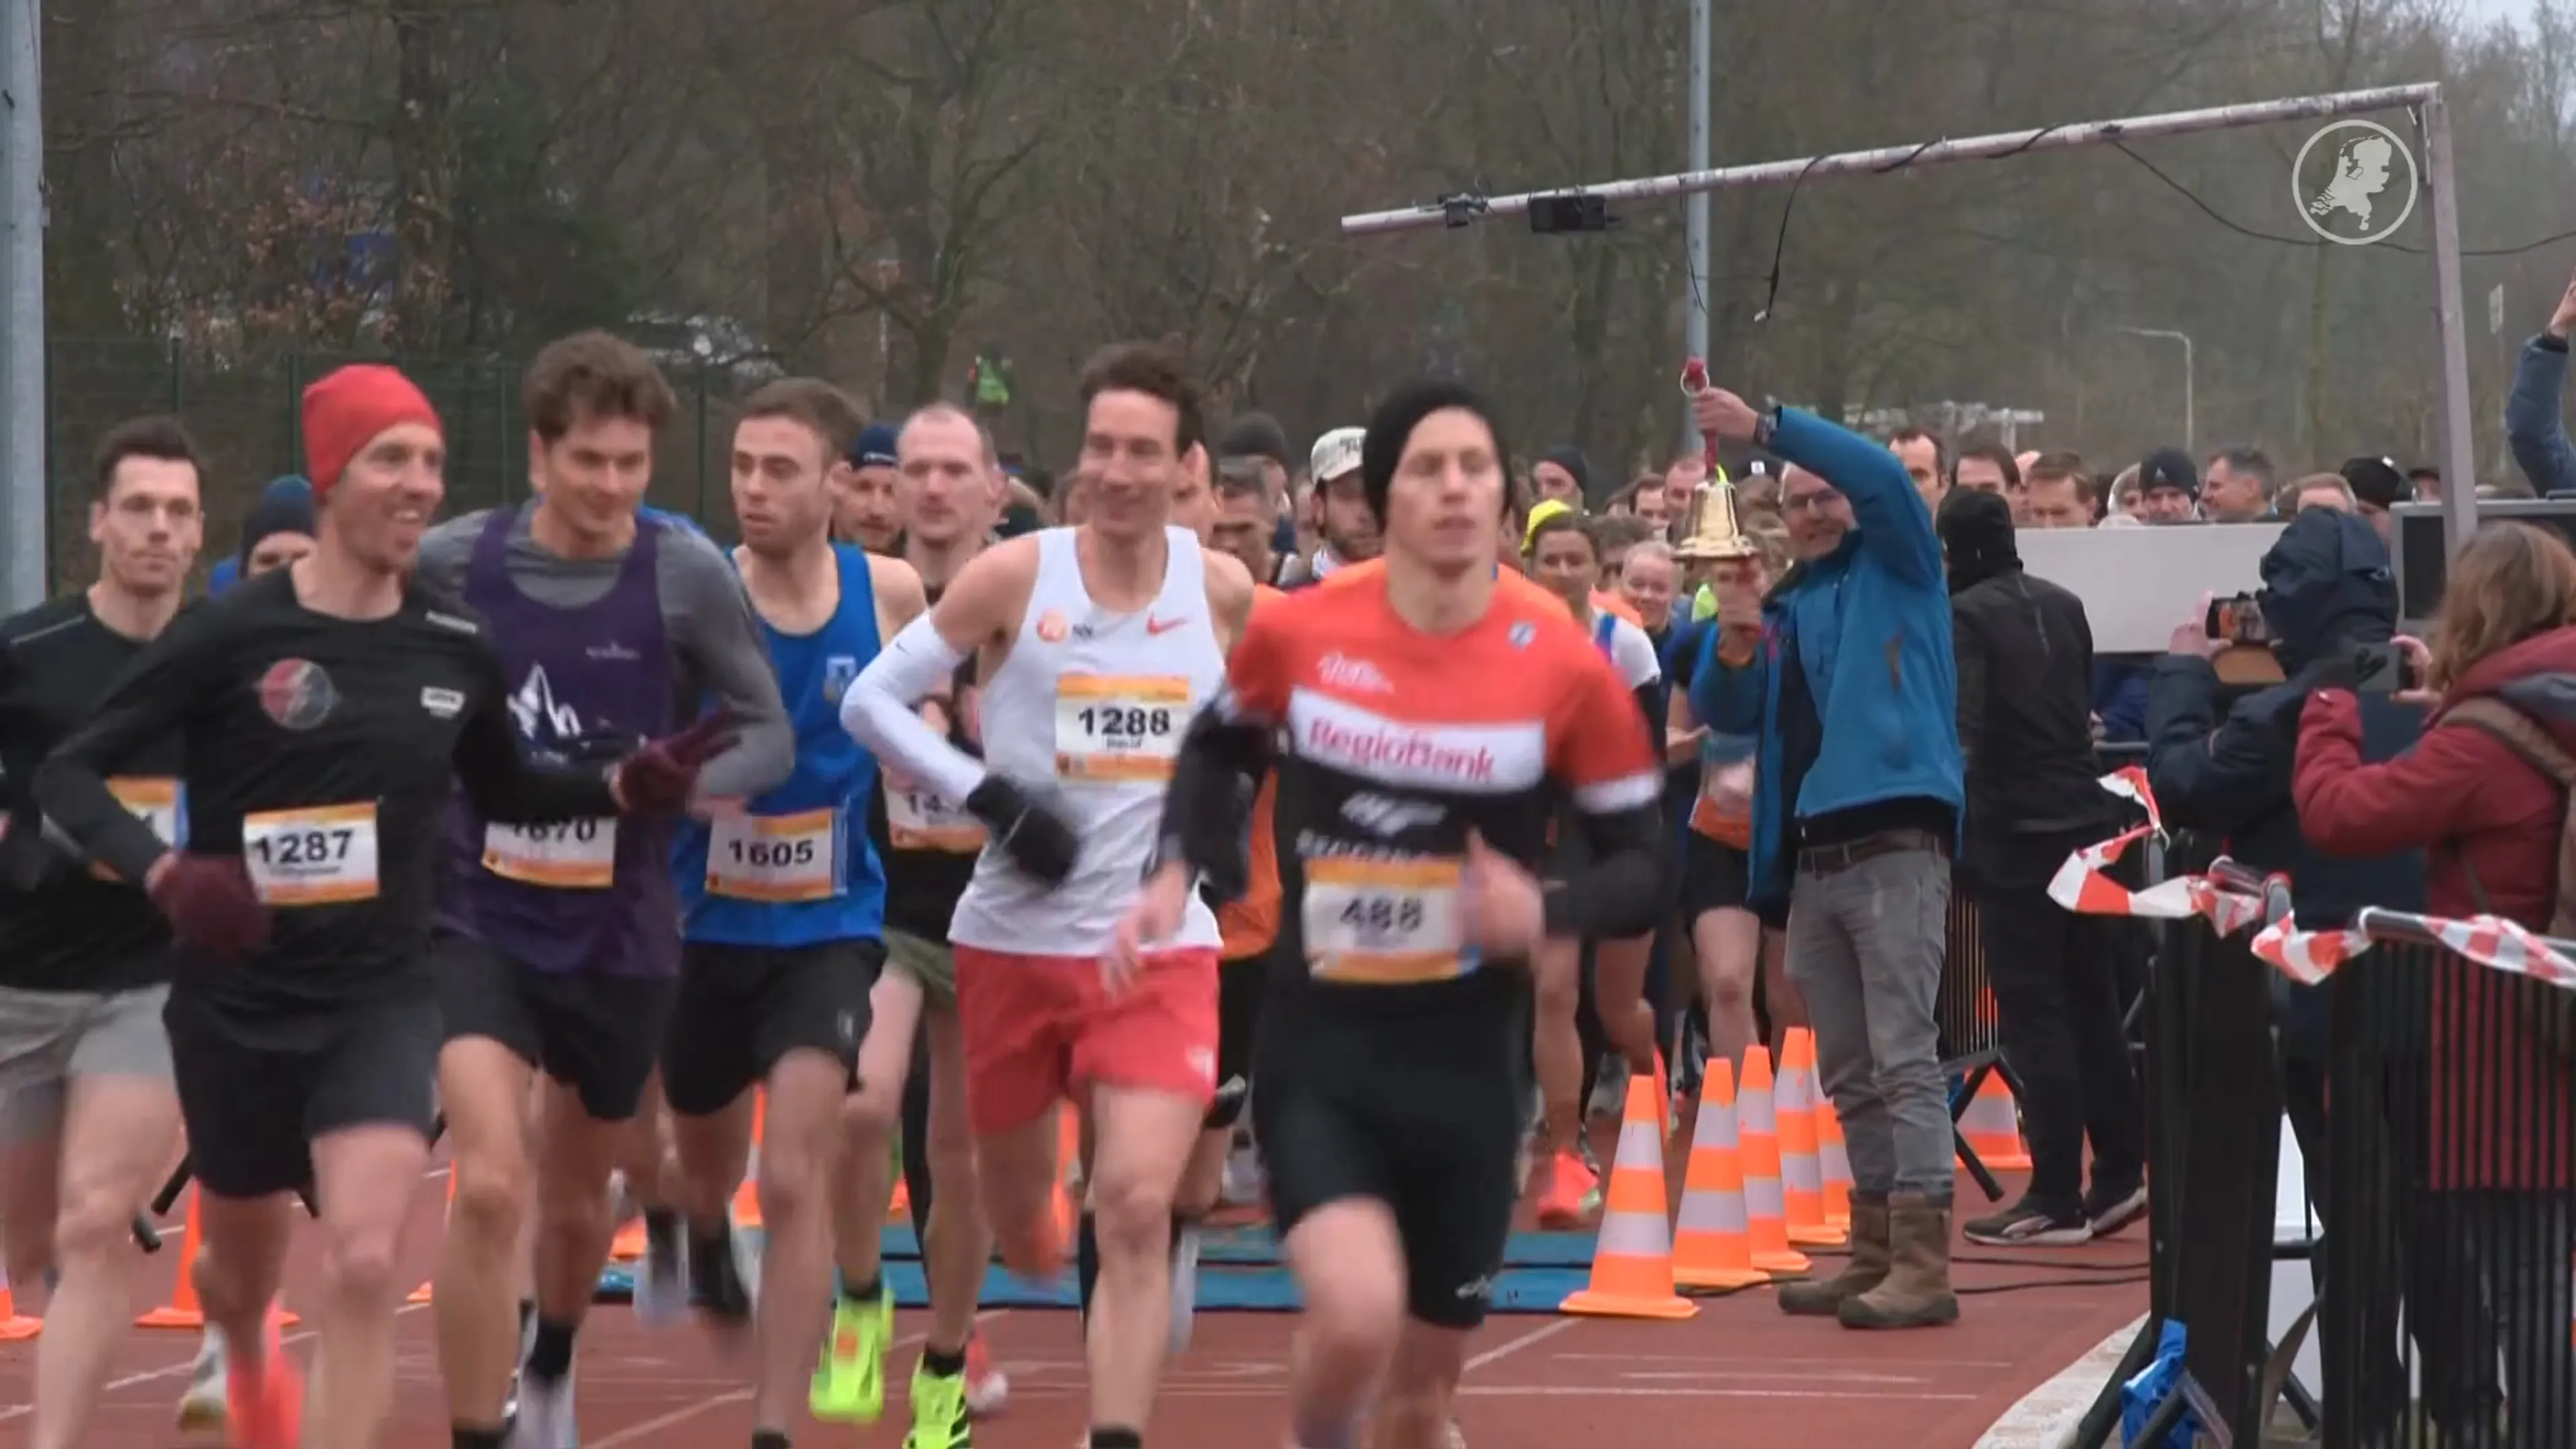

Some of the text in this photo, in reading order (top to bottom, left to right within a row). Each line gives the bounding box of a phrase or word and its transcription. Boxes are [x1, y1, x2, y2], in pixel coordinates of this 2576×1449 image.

[1078, 706, 1171, 737] 1288
[1309, 716, 1495, 784] RegioBank
[253, 828, 354, 863] 1287
[728, 839, 814, 867] 1605
[1340, 896, 1423, 932] 488
